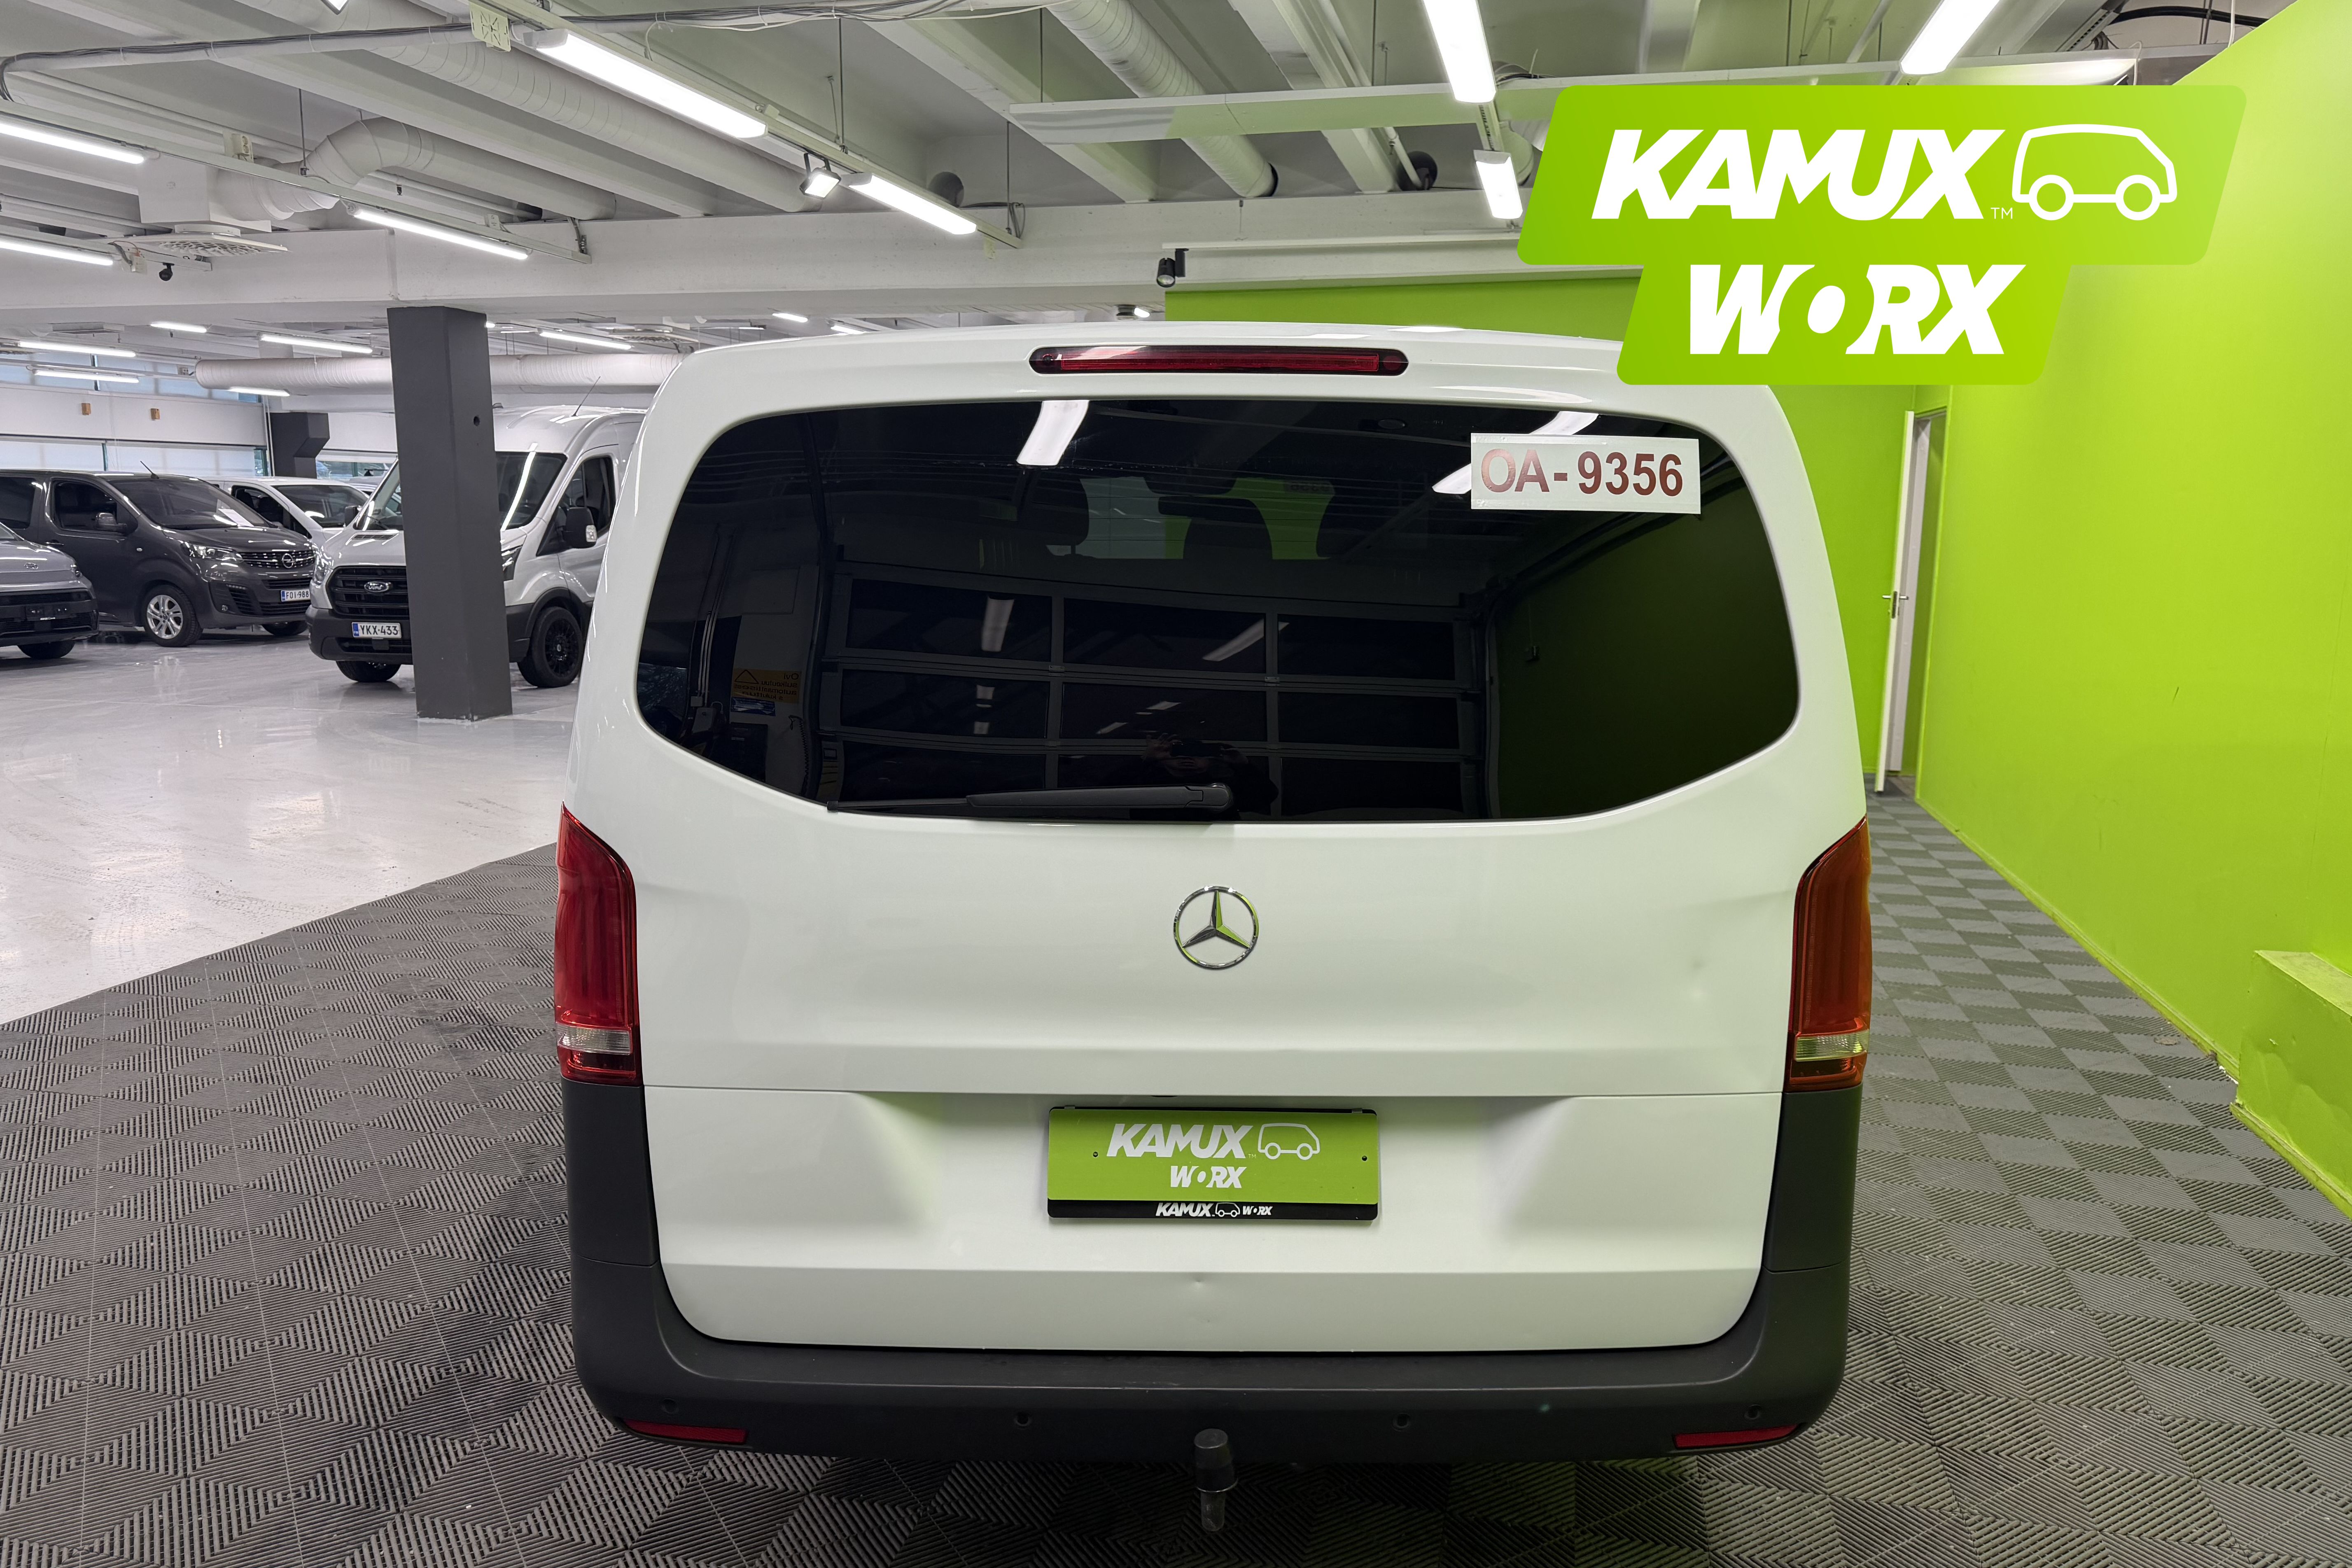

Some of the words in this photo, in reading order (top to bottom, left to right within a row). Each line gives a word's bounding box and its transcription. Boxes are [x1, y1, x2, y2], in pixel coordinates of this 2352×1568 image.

[359, 625, 399, 635] YKX-433
[1106, 1123, 1253, 1159] KAMUX
[1170, 1165, 1247, 1188] WORX
[1155, 1202, 1214, 1217] KAMUX
[1243, 1206, 1273, 1216] WORX
